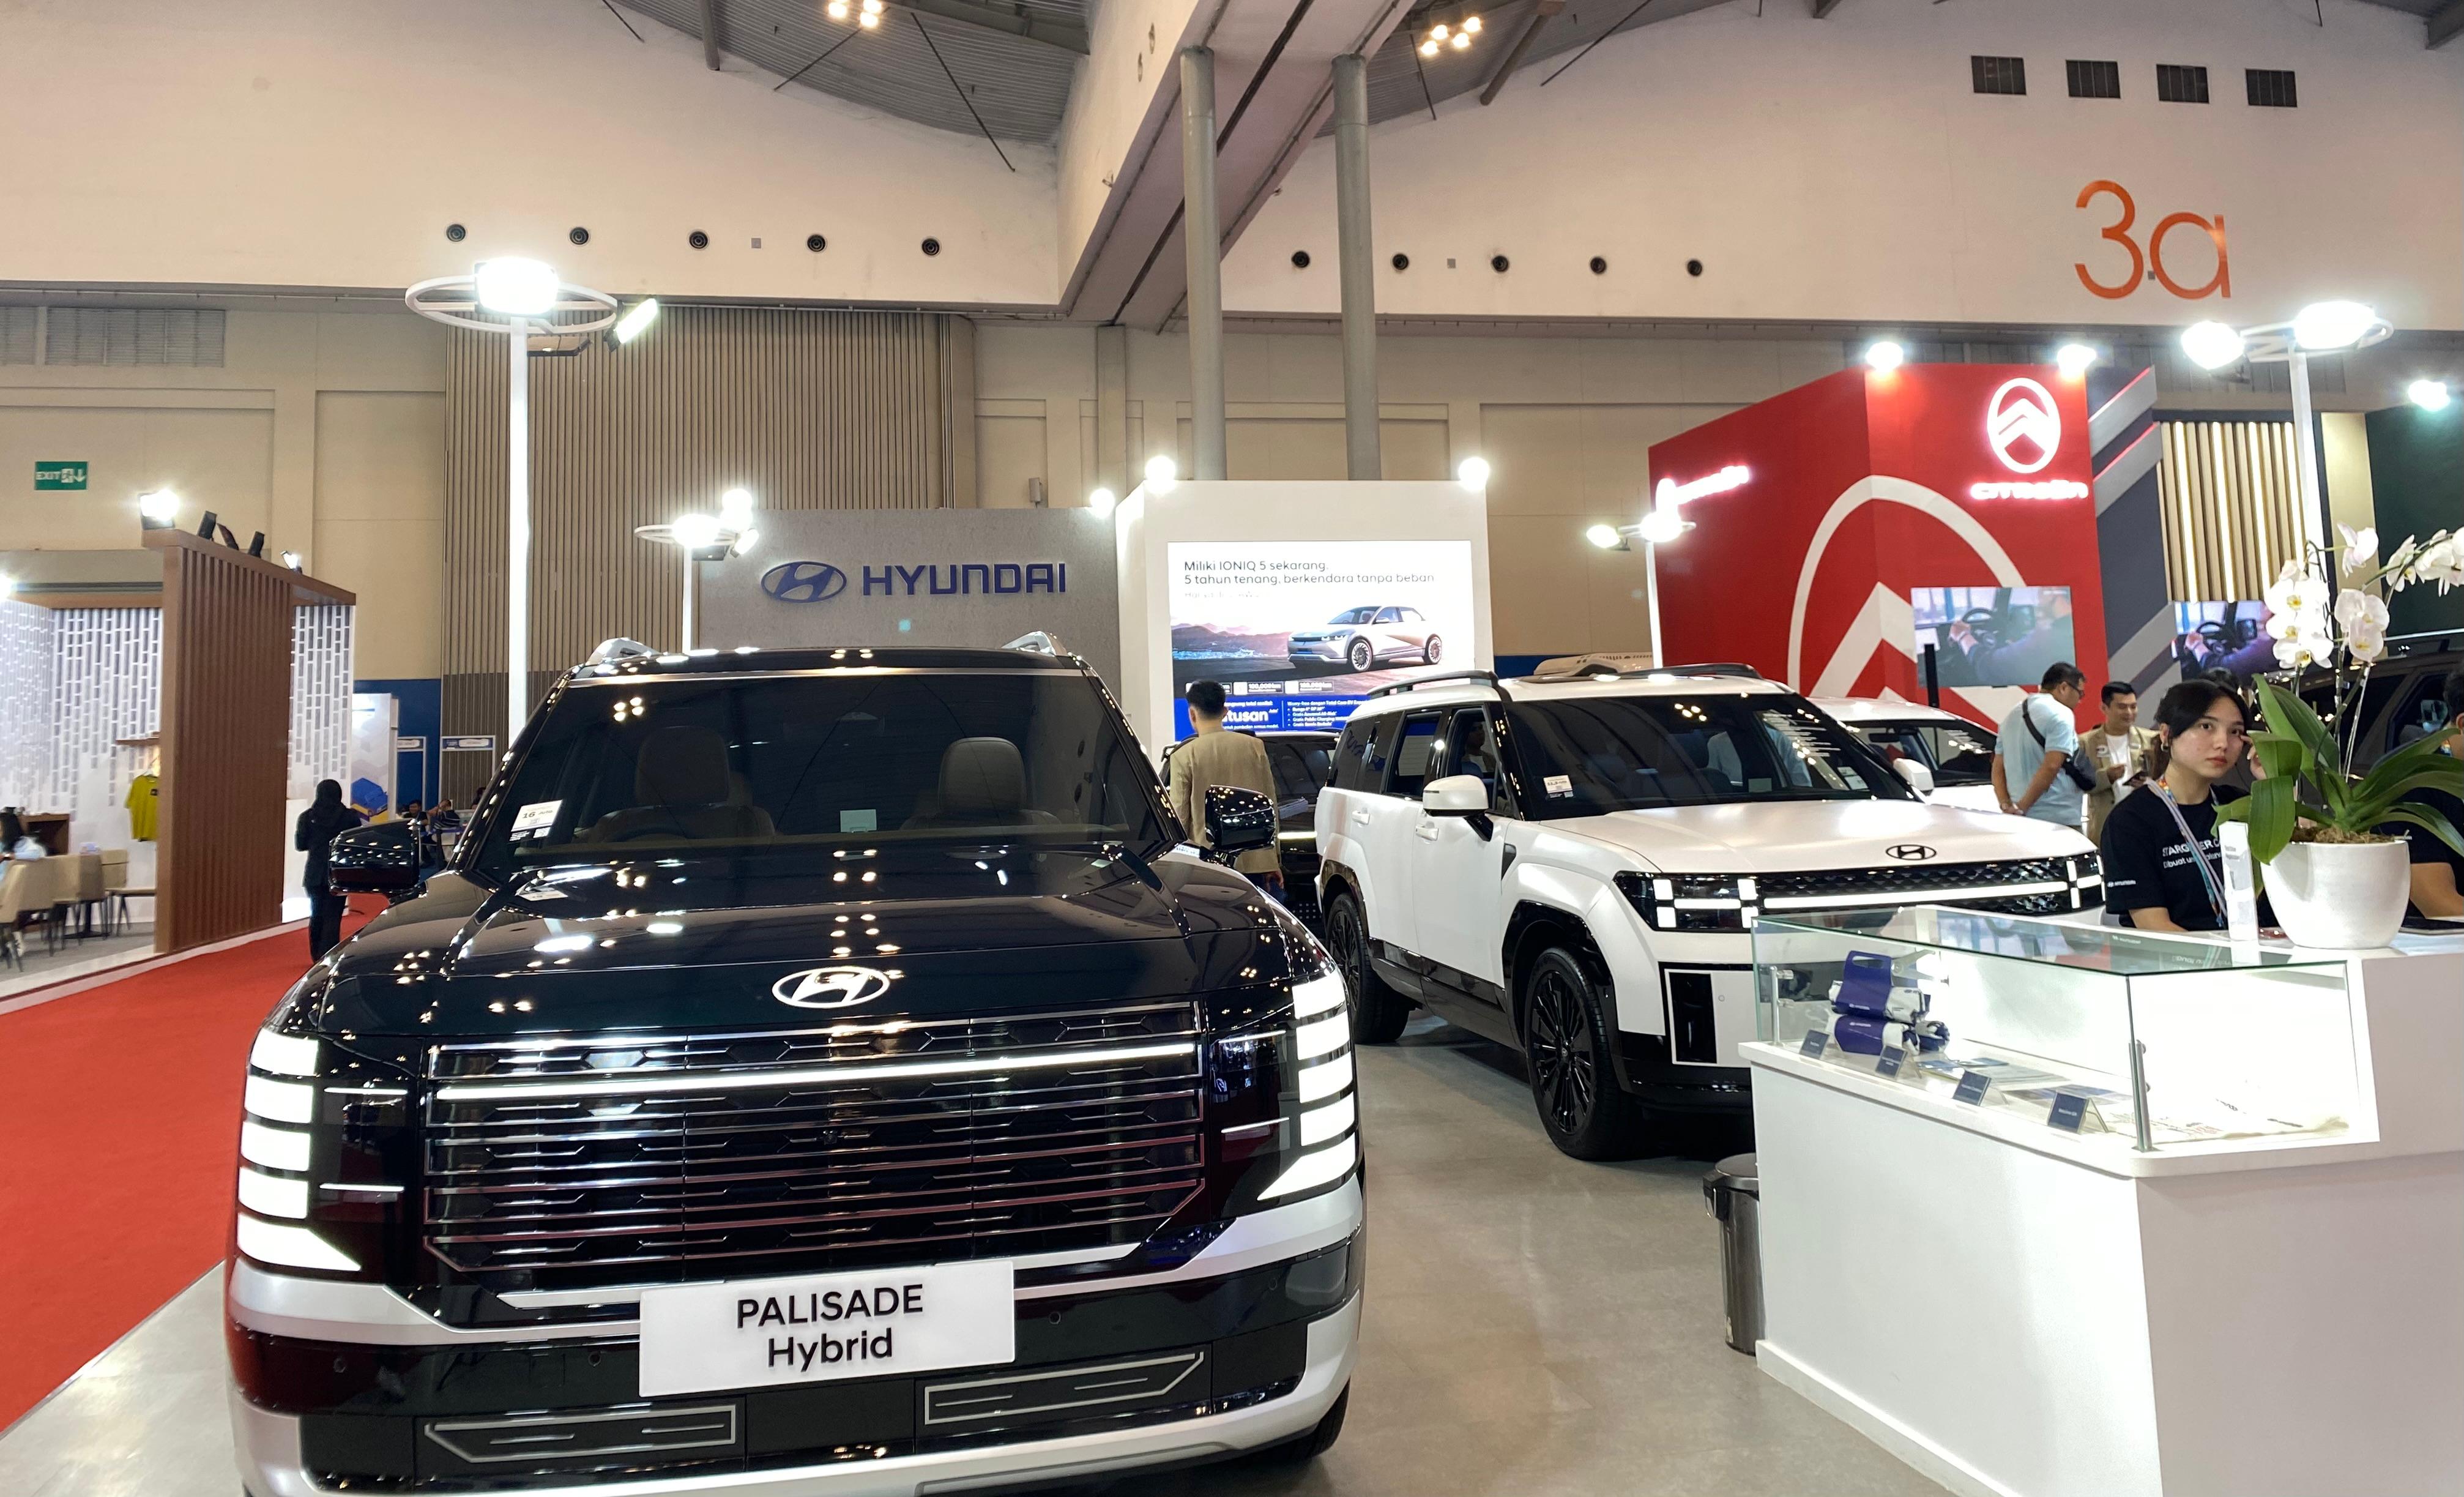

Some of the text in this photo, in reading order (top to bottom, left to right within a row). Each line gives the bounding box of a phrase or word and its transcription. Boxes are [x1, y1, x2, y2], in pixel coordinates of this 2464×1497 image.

[35, 471, 61, 480] EXIT
[1185, 561, 1216, 570] Miliki
[1219, 561, 1256, 572] IONIQ
[1259, 561, 1267, 570] 5
[863, 563, 1066, 595] HYUNDAI
[1185, 574, 1192, 584] 5
[1194, 574, 1231, 584] tahun
[1284, 573, 1353, 583] berkendara
[1357, 574, 1393, 584] tanpa
[736, 1284, 923, 1329] PALISADE
[767, 1327, 893, 1372] Hybrid
